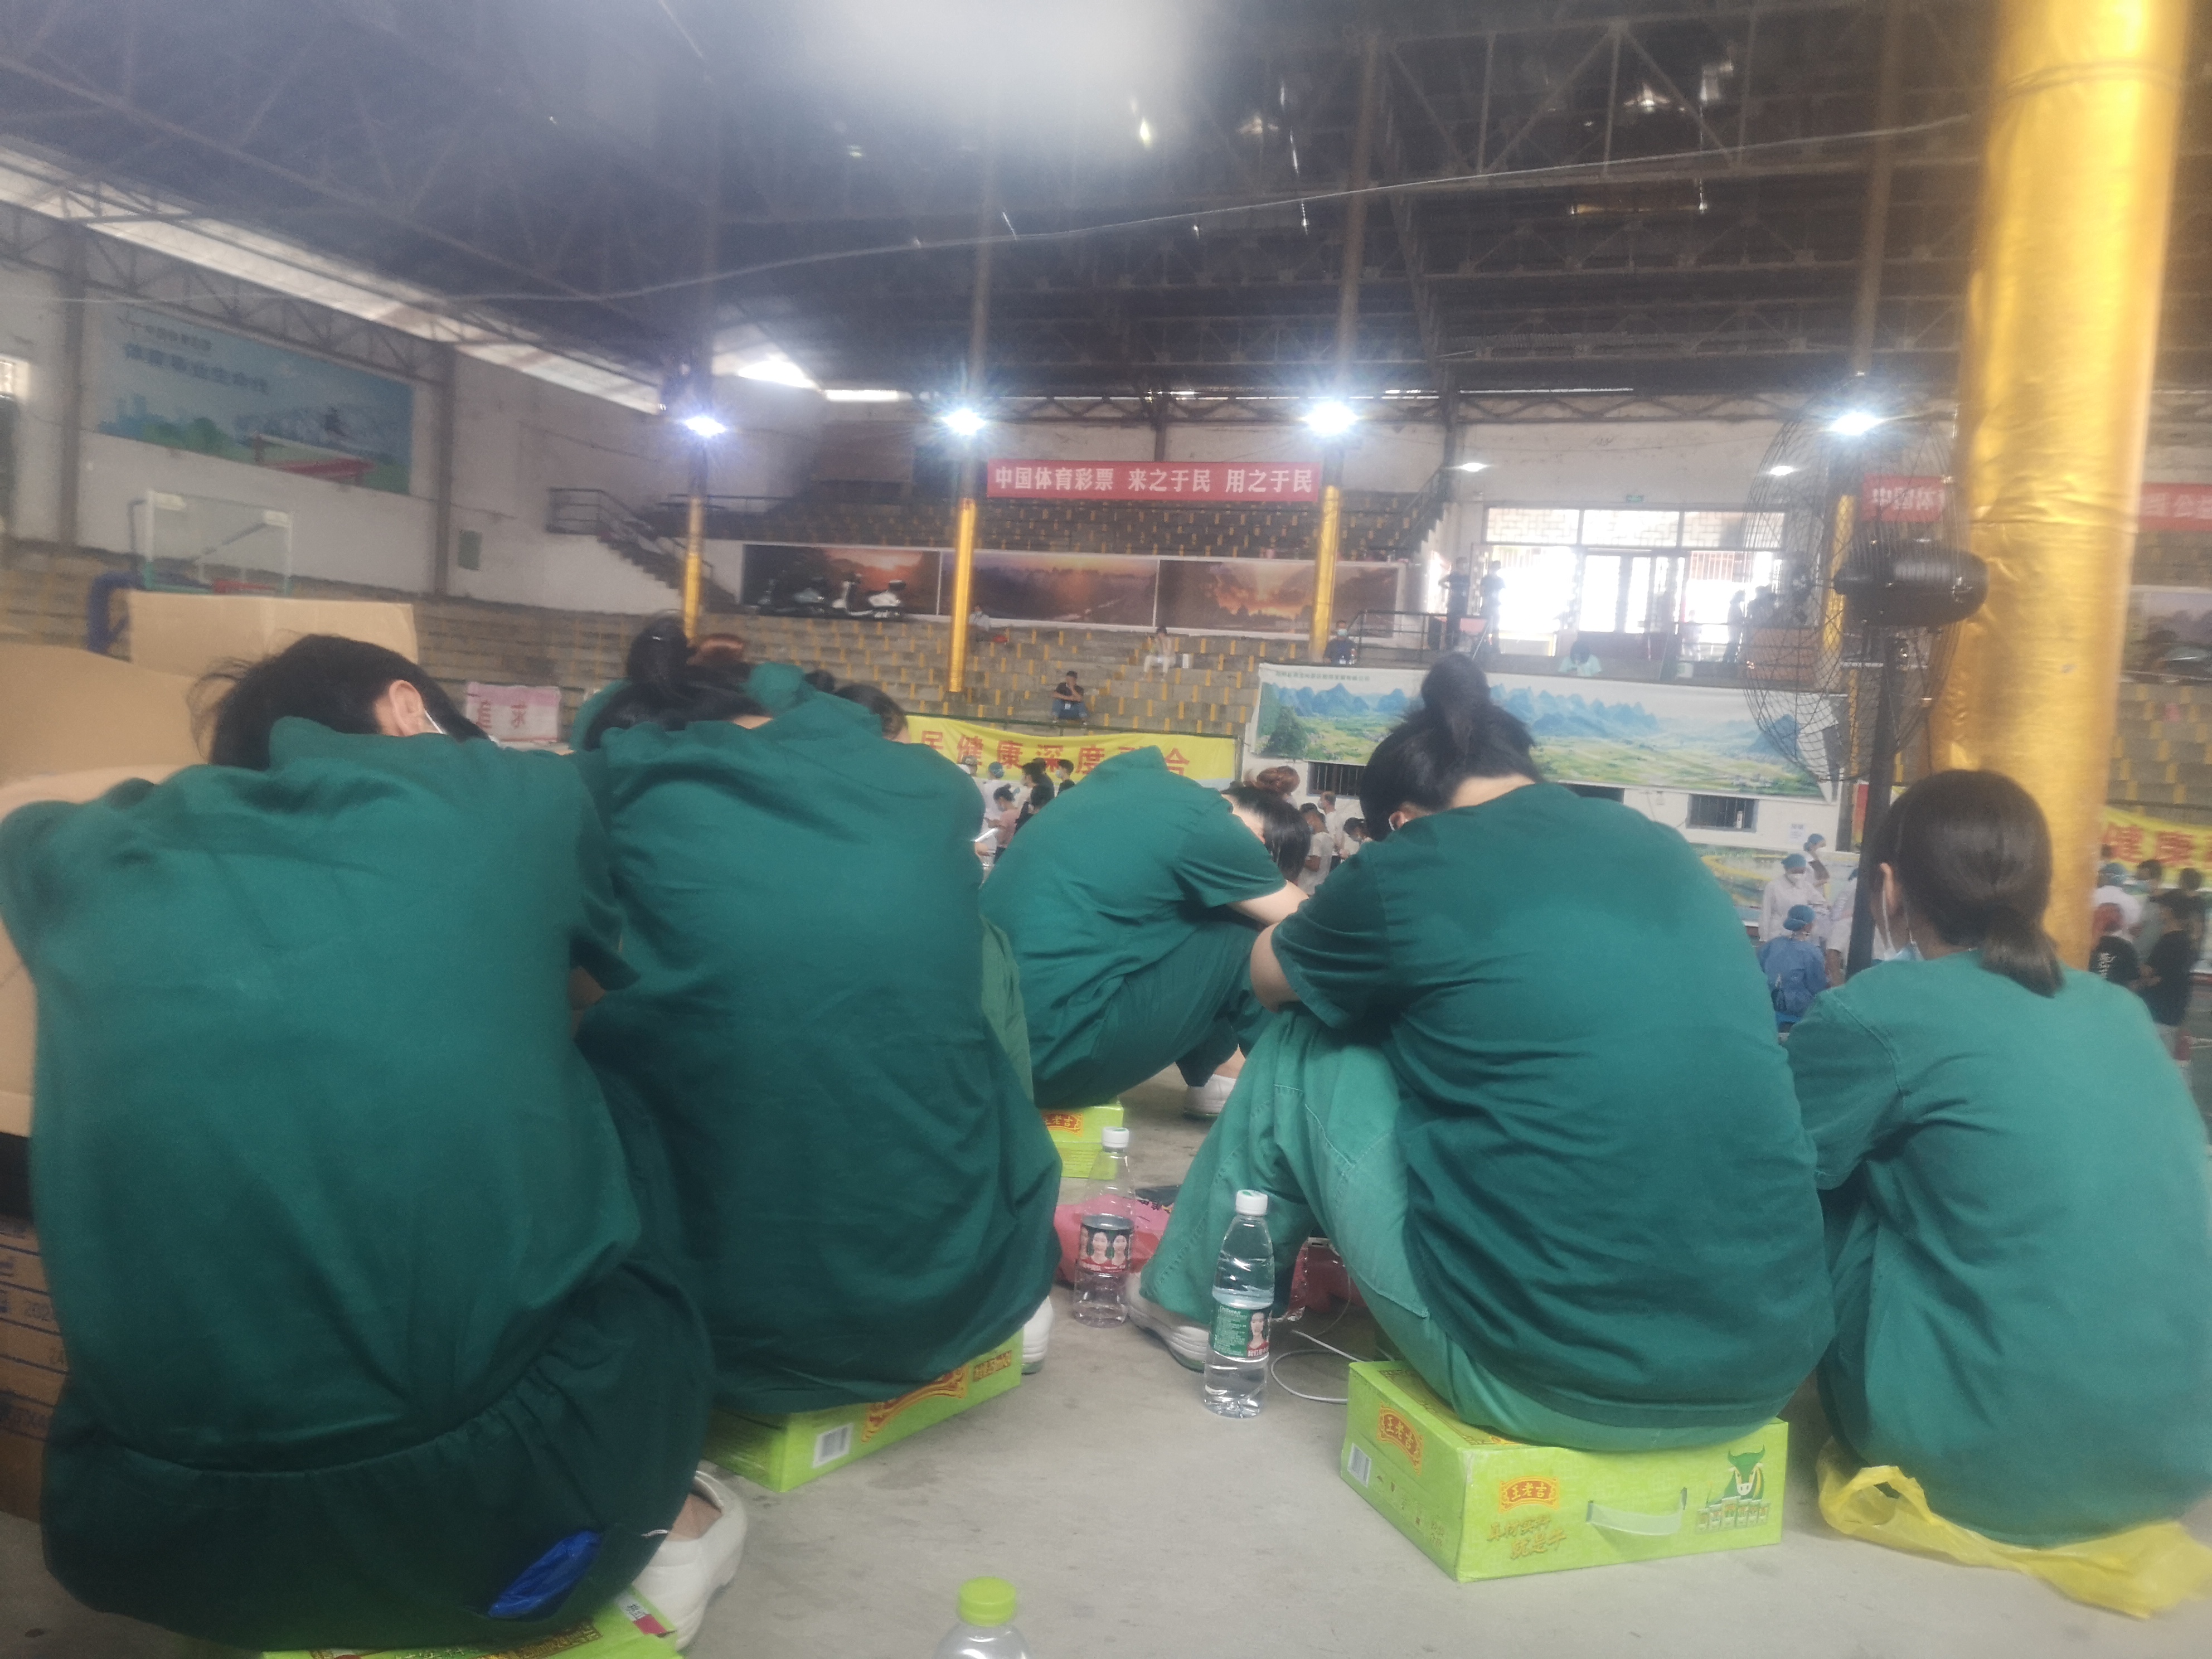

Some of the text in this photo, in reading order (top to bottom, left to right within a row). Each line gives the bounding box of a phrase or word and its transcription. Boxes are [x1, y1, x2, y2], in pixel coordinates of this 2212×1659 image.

[995, 466, 1313, 493] 中国体育彩票 来之于民 用之于民
[920, 730, 1190, 777] 民健康深度合
[1385, 1417, 1415, 1450] 王老吉
[1511, 1482, 1548, 1500] 王老吉
